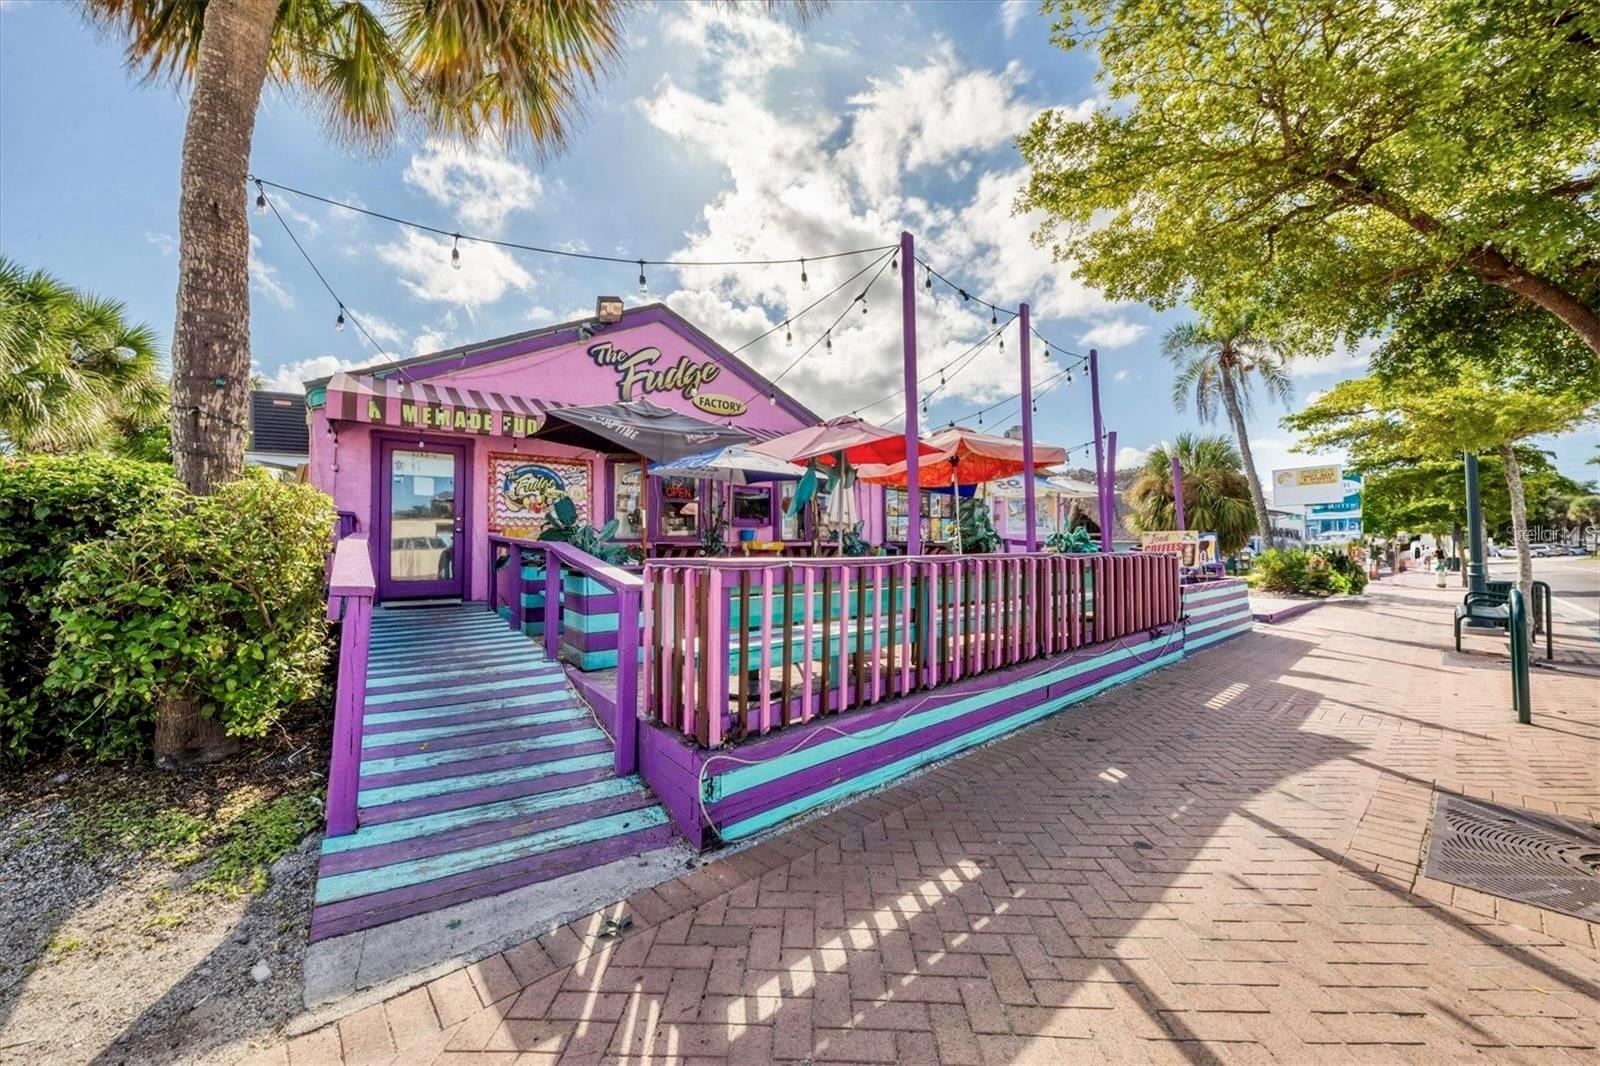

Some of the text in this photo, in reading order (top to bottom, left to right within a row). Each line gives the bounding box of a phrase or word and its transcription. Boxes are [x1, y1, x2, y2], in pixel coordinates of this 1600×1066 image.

[588, 342, 629, 366] The
[616, 347, 721, 403] Fudge
[700, 397, 742, 412] FACTORY
[502, 416, 544, 435] FUD
[666, 487, 692, 498] OPEN
[1145, 543, 1183, 552] COFFEES
